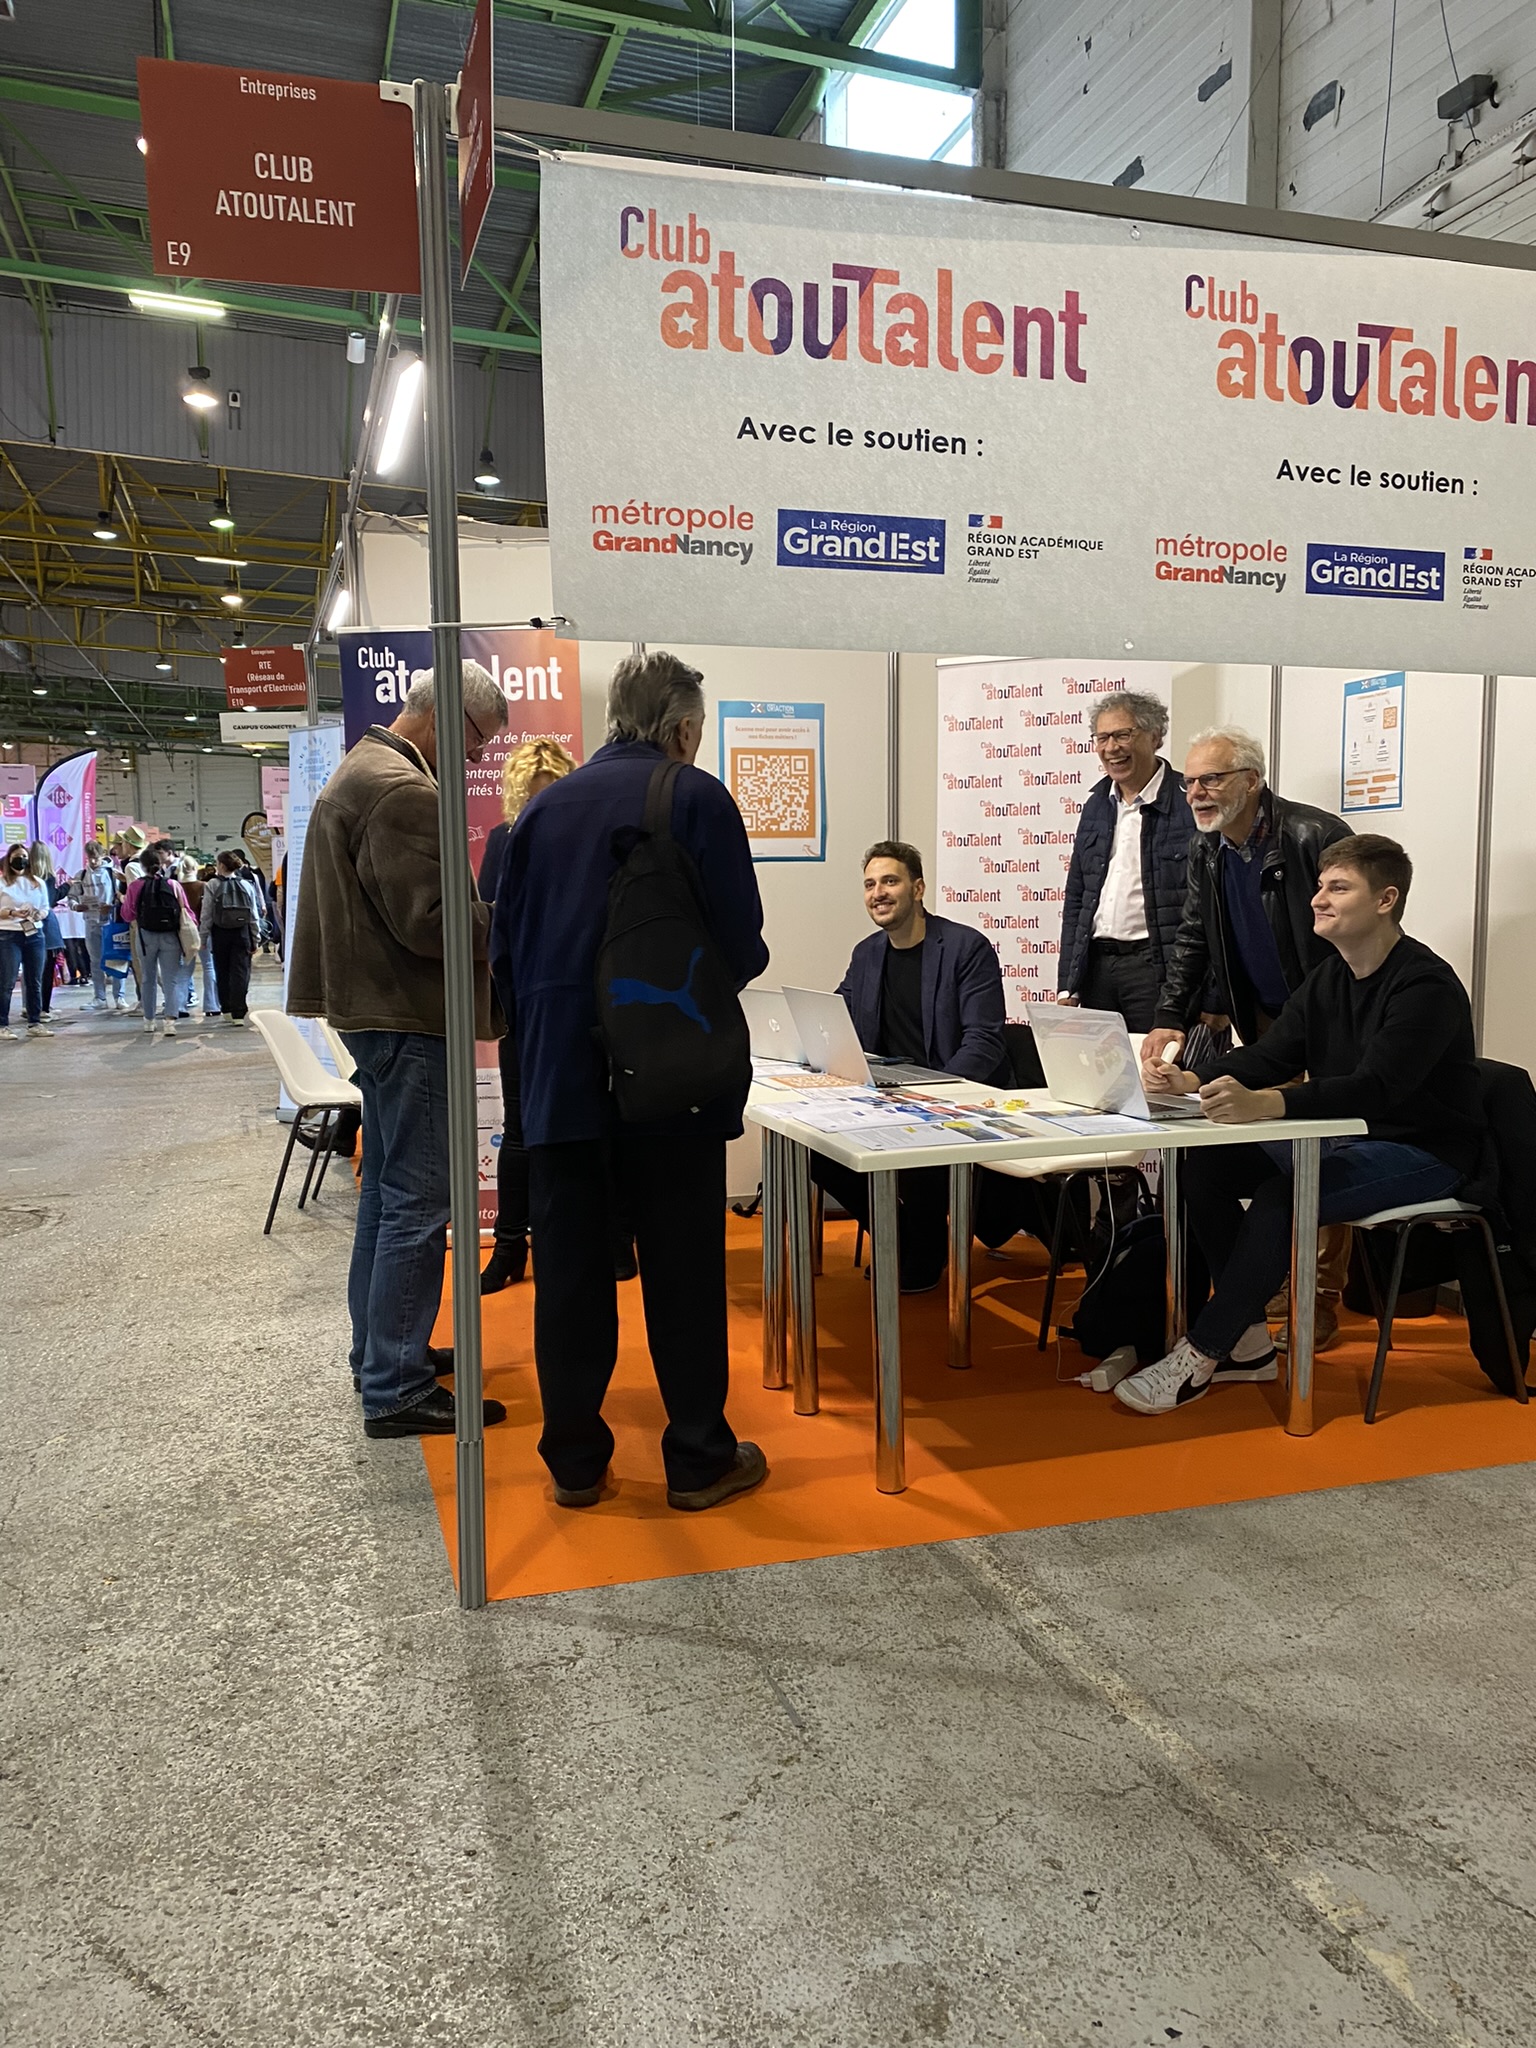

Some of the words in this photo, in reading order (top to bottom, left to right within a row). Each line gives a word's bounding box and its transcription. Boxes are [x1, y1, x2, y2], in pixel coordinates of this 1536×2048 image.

[240, 76, 317, 101] Entreprises
[254, 151, 314, 183] CLUB
[215, 189, 356, 228] ATOUTALENT
[619, 205, 711, 266] Club
[167, 240, 192, 267] E9
[1185, 274, 1259, 325] Club
[659, 250, 1088, 384] atouTalent
[1216, 312, 1536, 426] atouTalen
[736, 416, 817, 445] Avec
[827, 421, 854, 447] le
[863, 428, 967, 455] soutien
[1276, 458, 1341, 485] Avec
[1350, 464, 1372, 487] le
[1379, 470, 1464, 495] soutien
[592, 499, 754, 534] métropole
[811, 518, 827, 530] La
[831, 519, 876, 533] Région
[967, 531, 1017, 546] RÉGION
[1020, 536, 1104, 552] ACADÉMIQUE
[1155, 533, 1288, 565] métropole
[967, 545, 1015, 558] GRAND
[1018, 548, 1040, 560] EST
[1334, 552, 1348, 562] La
[1350, 552, 1388, 565] Région
[1463, 562, 1504, 576] RÉGION
[1462, 576, 1502, 587] GRAND
[1504, 578, 1523, 588] EST
[258, 661, 272, 670] RTE
[358, 646, 395, 669] Club
[247, 673, 275, 683] (Réseau
[276, 672, 285, 681] de
[229, 685, 262, 695] Transport
[986, 683, 1043, 700] atouTalent
[1067, 678, 1126, 694] atouTalent
[232, 698, 244, 707] E10
[948, 716, 1004, 732] atouTalent
[1024, 710, 1082, 727] atouTalent
[503, 732, 518, 744] de
[986, 743, 1042, 759] atouTalent
[948, 774, 1003, 790] atouTalent
[1024, 770, 1081, 786] atouTalent
[984, 802, 1041, 818] atouTalent
[946, 832, 1002, 848] atouTalent
[984, 859, 1040, 873] atouTalent
[946, 888, 1001, 902] atouTalent
[984, 915, 1040, 929] atouTalent
